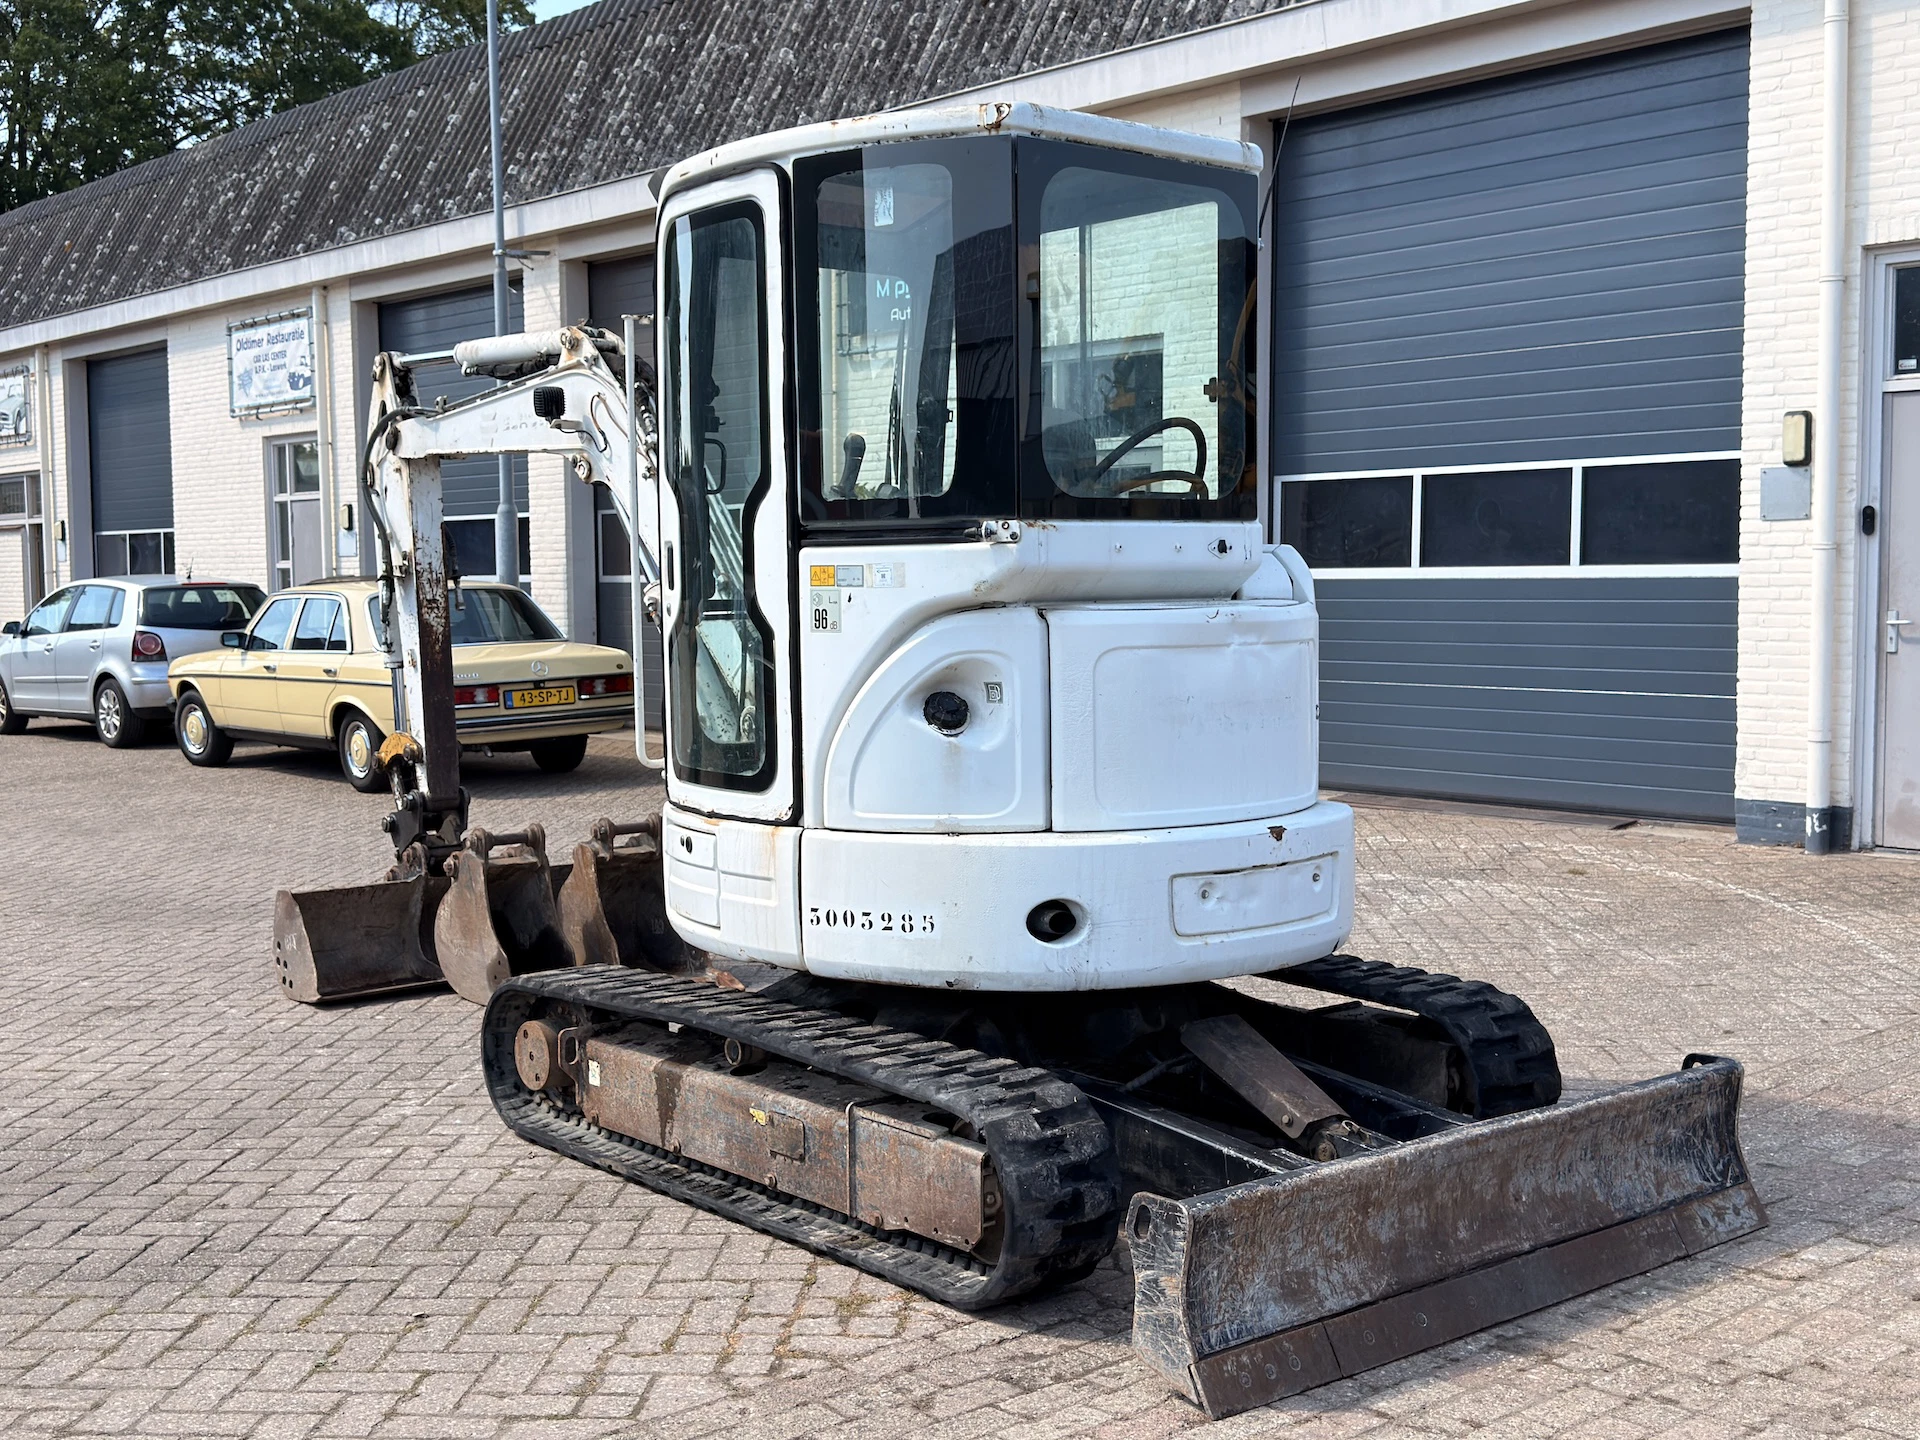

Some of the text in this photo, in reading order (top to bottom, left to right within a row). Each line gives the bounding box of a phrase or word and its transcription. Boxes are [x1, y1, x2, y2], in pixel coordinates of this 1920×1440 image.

[876, 278, 890, 298] M
[236, 327, 305, 352] Oldtimer Restauratie
[271, 350, 288, 361] CENTER
[814, 608, 828, 630] 96
[520, 689, 570, 704] 43-SP-TJ
[810, 907, 935, 933] 3003285
